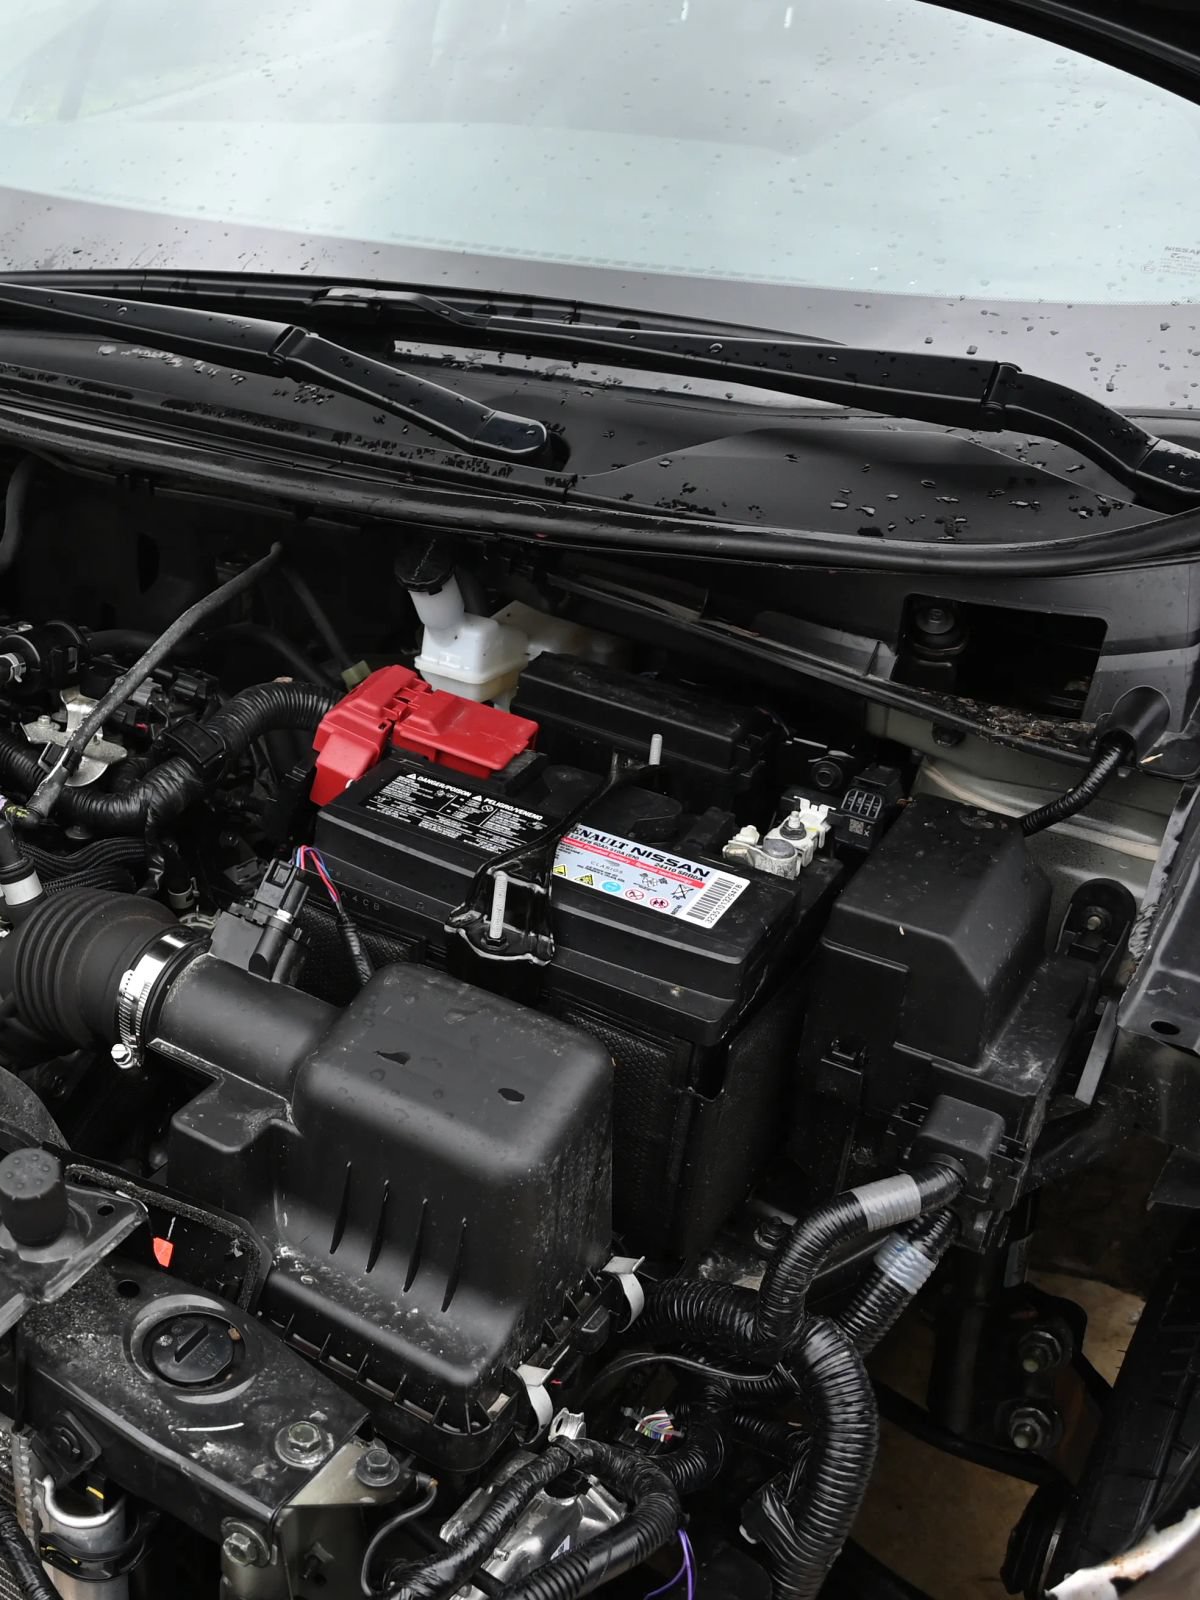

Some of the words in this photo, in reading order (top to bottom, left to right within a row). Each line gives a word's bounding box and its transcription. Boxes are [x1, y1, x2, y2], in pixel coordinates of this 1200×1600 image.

[417, 775, 472, 797] DANGER/POISON
[484, 797, 543, 821] PELIGRO/VENENO
[574, 828, 629, 849] ENAULT
[631, 846, 710, 878] NISSAN
